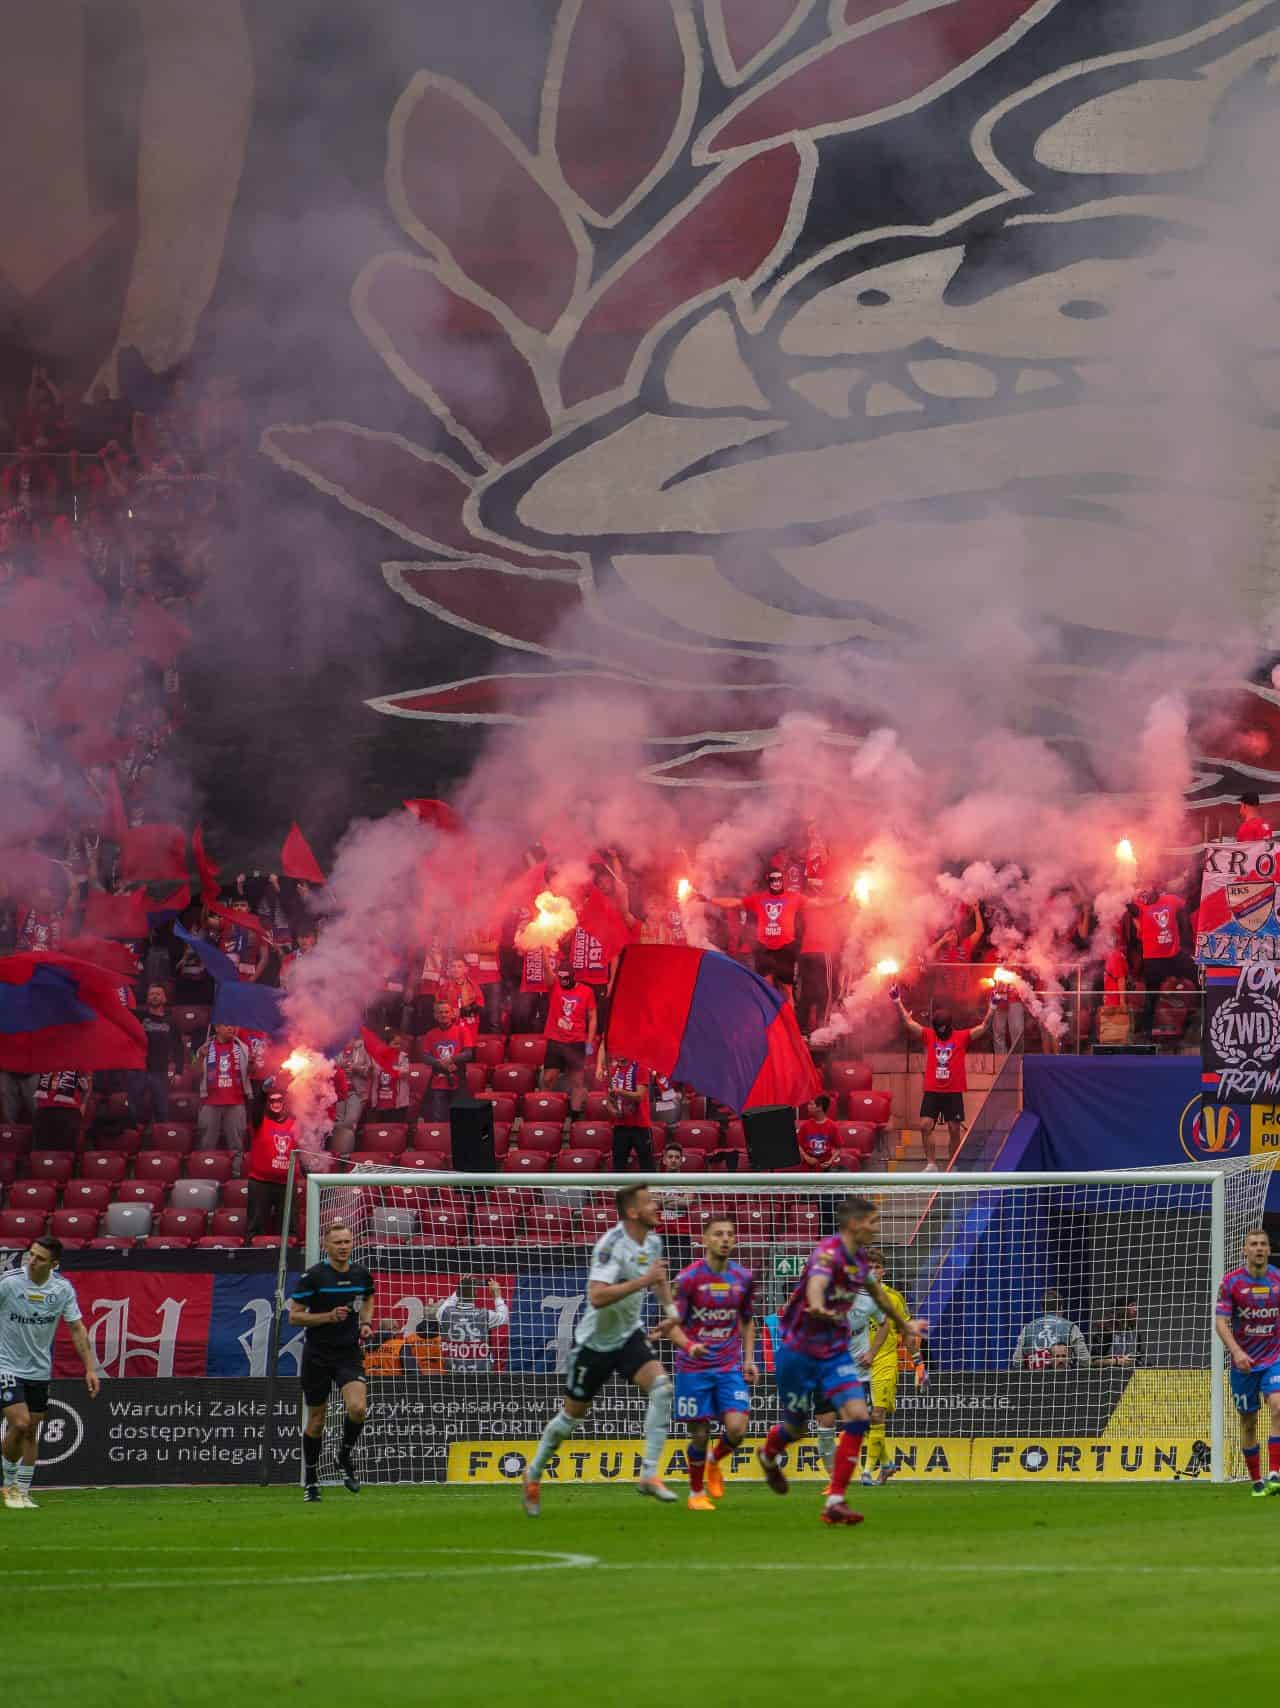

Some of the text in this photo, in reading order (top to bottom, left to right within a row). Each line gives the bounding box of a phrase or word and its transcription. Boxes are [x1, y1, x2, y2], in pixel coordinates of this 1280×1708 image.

[1223, 1012, 1271, 1046] ZWD
[442, 1342, 489, 1358] PHOTO
[109, 1400, 200, 1417] Warunki
[364, 1399, 424, 1418] yzyka
[432, 1399, 514, 1419] opisano
[678, 1397, 699, 1417] 66
[108, 1424, 235, 1442] dostępnym
[108, 1446, 148, 1462] Gra
[157, 1450, 169, 1462] u
[990, 1445, 1213, 1473] FORTUNA
